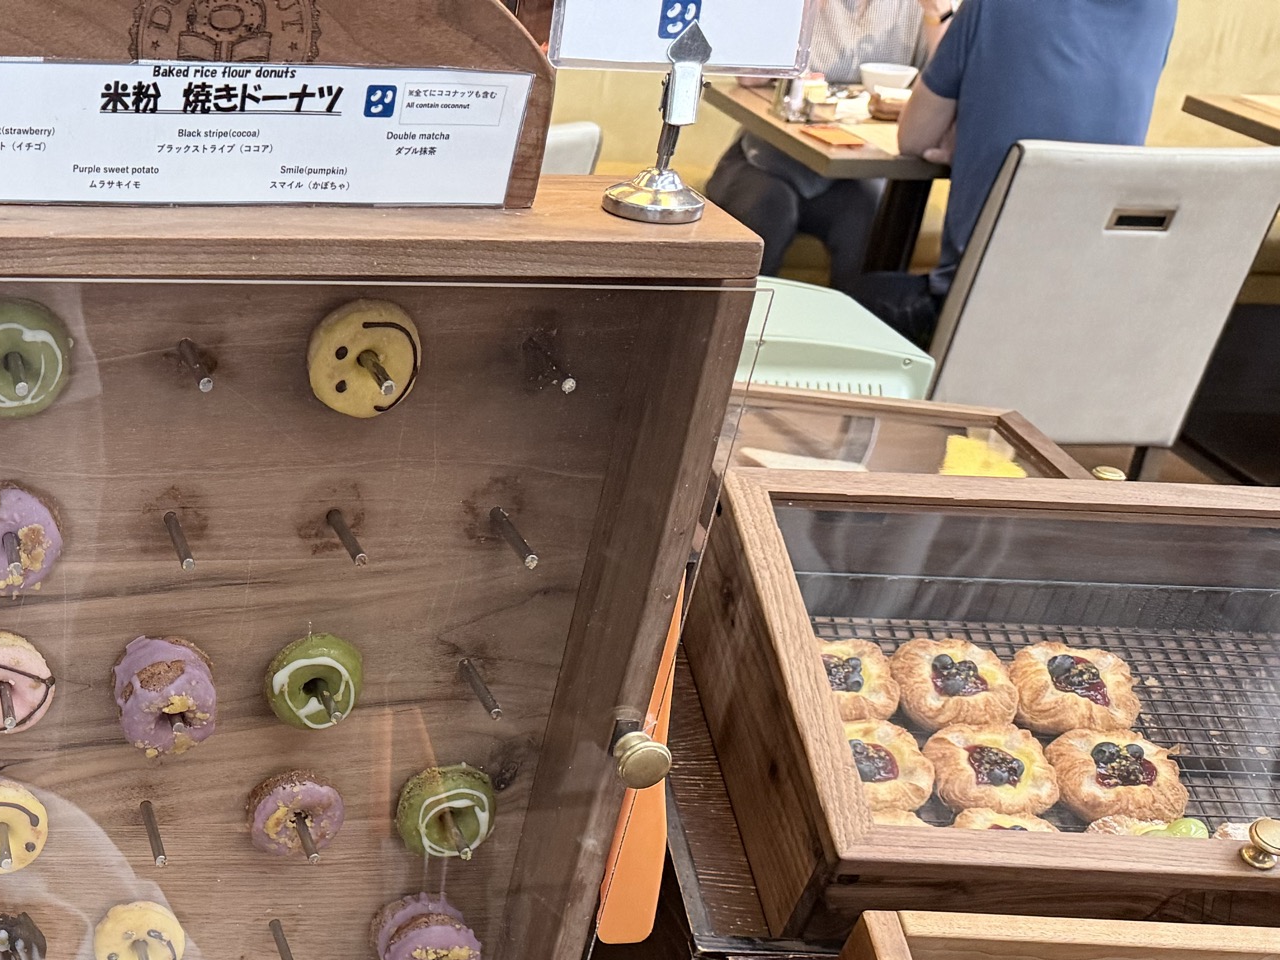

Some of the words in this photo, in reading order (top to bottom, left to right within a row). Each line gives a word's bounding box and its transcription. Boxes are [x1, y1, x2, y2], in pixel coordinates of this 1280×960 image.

[153, 65, 189, 78] Baked
[193, 66, 218, 79] rice
[221, 66, 252, 79] flour
[255, 67, 297, 80] donuts
[100, 81, 161, 113] 米粉
[183, 81, 344, 114] 焼きドーナツ
[177, 128, 201, 138] Black
[204, 128, 260, 139] stripe(cocoa)
[386, 131, 417, 141] Double
[418, 132, 450, 141] matcha
[395, 146, 437, 156] ダブル抹茶
[73, 164, 101, 175] Purple
[103, 165, 129, 174] sweet
[131, 165, 160, 176] potato
[280, 165, 348, 177] Smile(pumpkin)
[89, 180, 141, 189] ムラサキイモ
